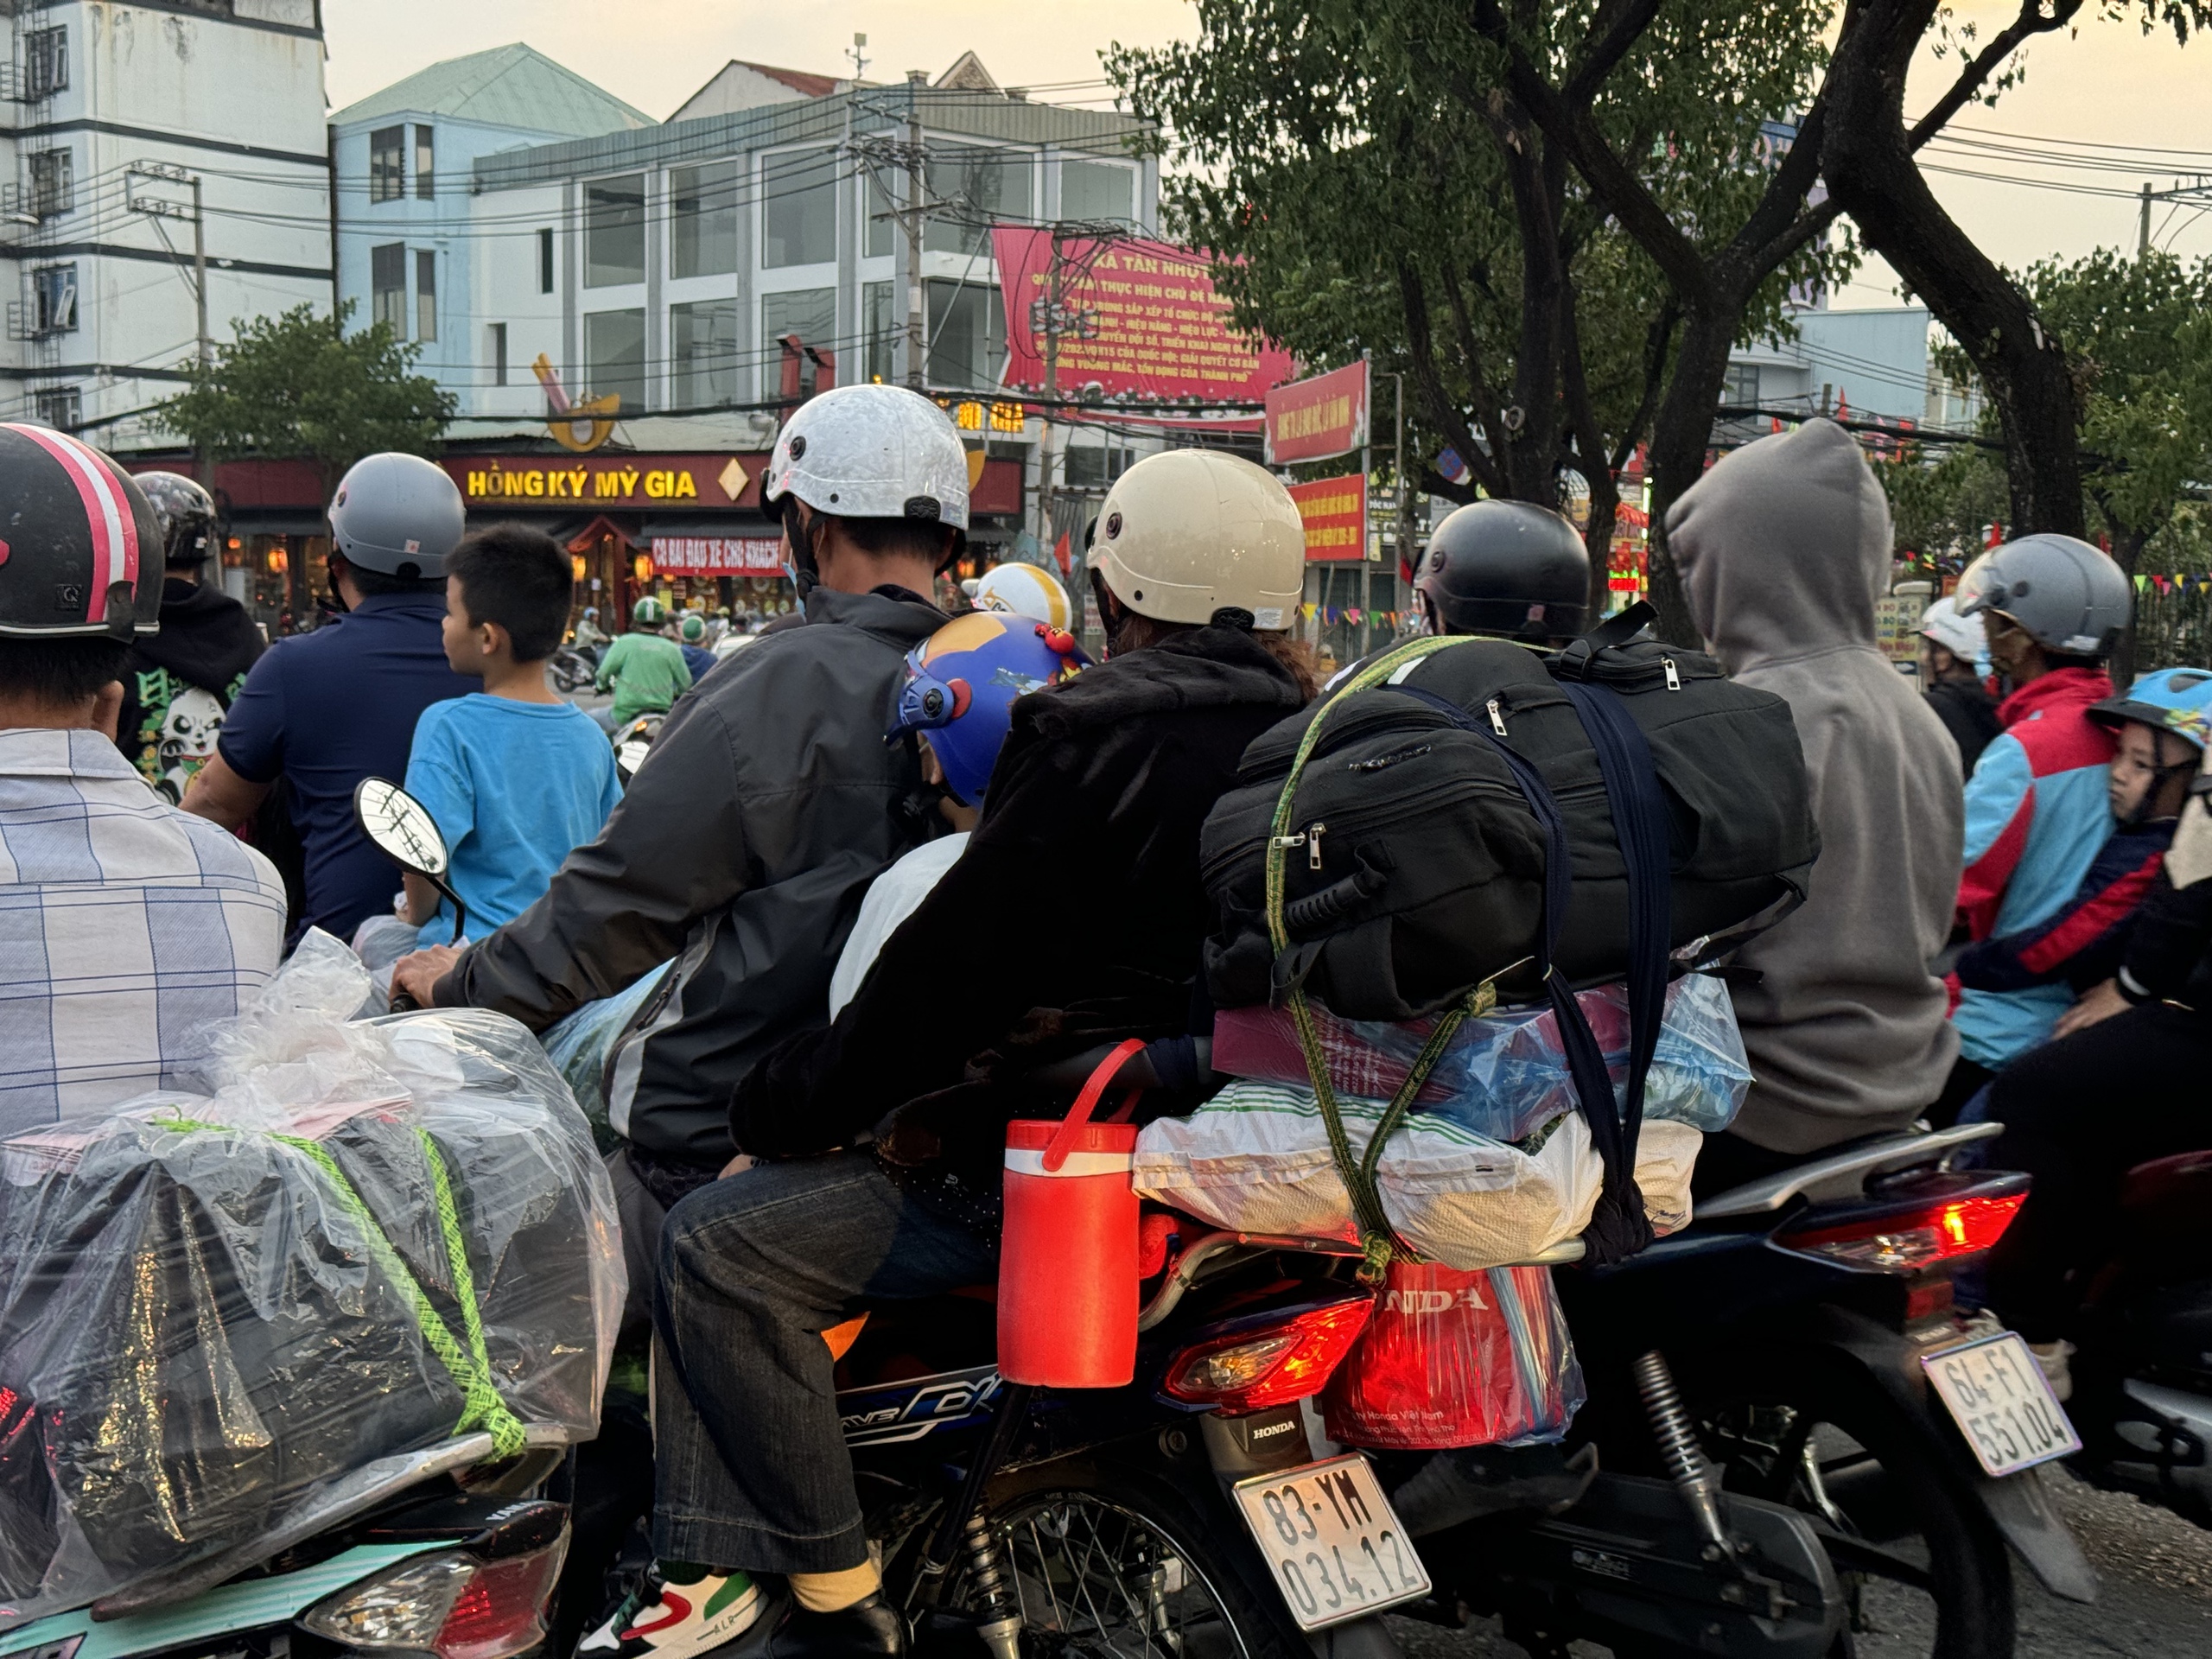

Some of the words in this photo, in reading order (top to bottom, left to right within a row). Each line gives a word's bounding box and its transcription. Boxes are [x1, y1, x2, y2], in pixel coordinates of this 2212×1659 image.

[1122, 253, 1157, 275] TÂN
[1100, 280, 1132, 296] THỰC
[1135, 283, 1162, 300] HIỆN
[467, 459, 544, 498] HỒNG
[644, 470, 697, 499] GIA
[1376, 1287, 1489, 1314] NDA
[1945, 1344, 2031, 1408] 64-F1
[841, 1407, 900, 1428] AVE
[1366, 1410, 1399, 1421] Honda
[1253, 1421, 1296, 1440] HONDA
[1967, 1396, 2069, 1466] 551.04
[1281, 1530, 1418, 1616] 034.12
